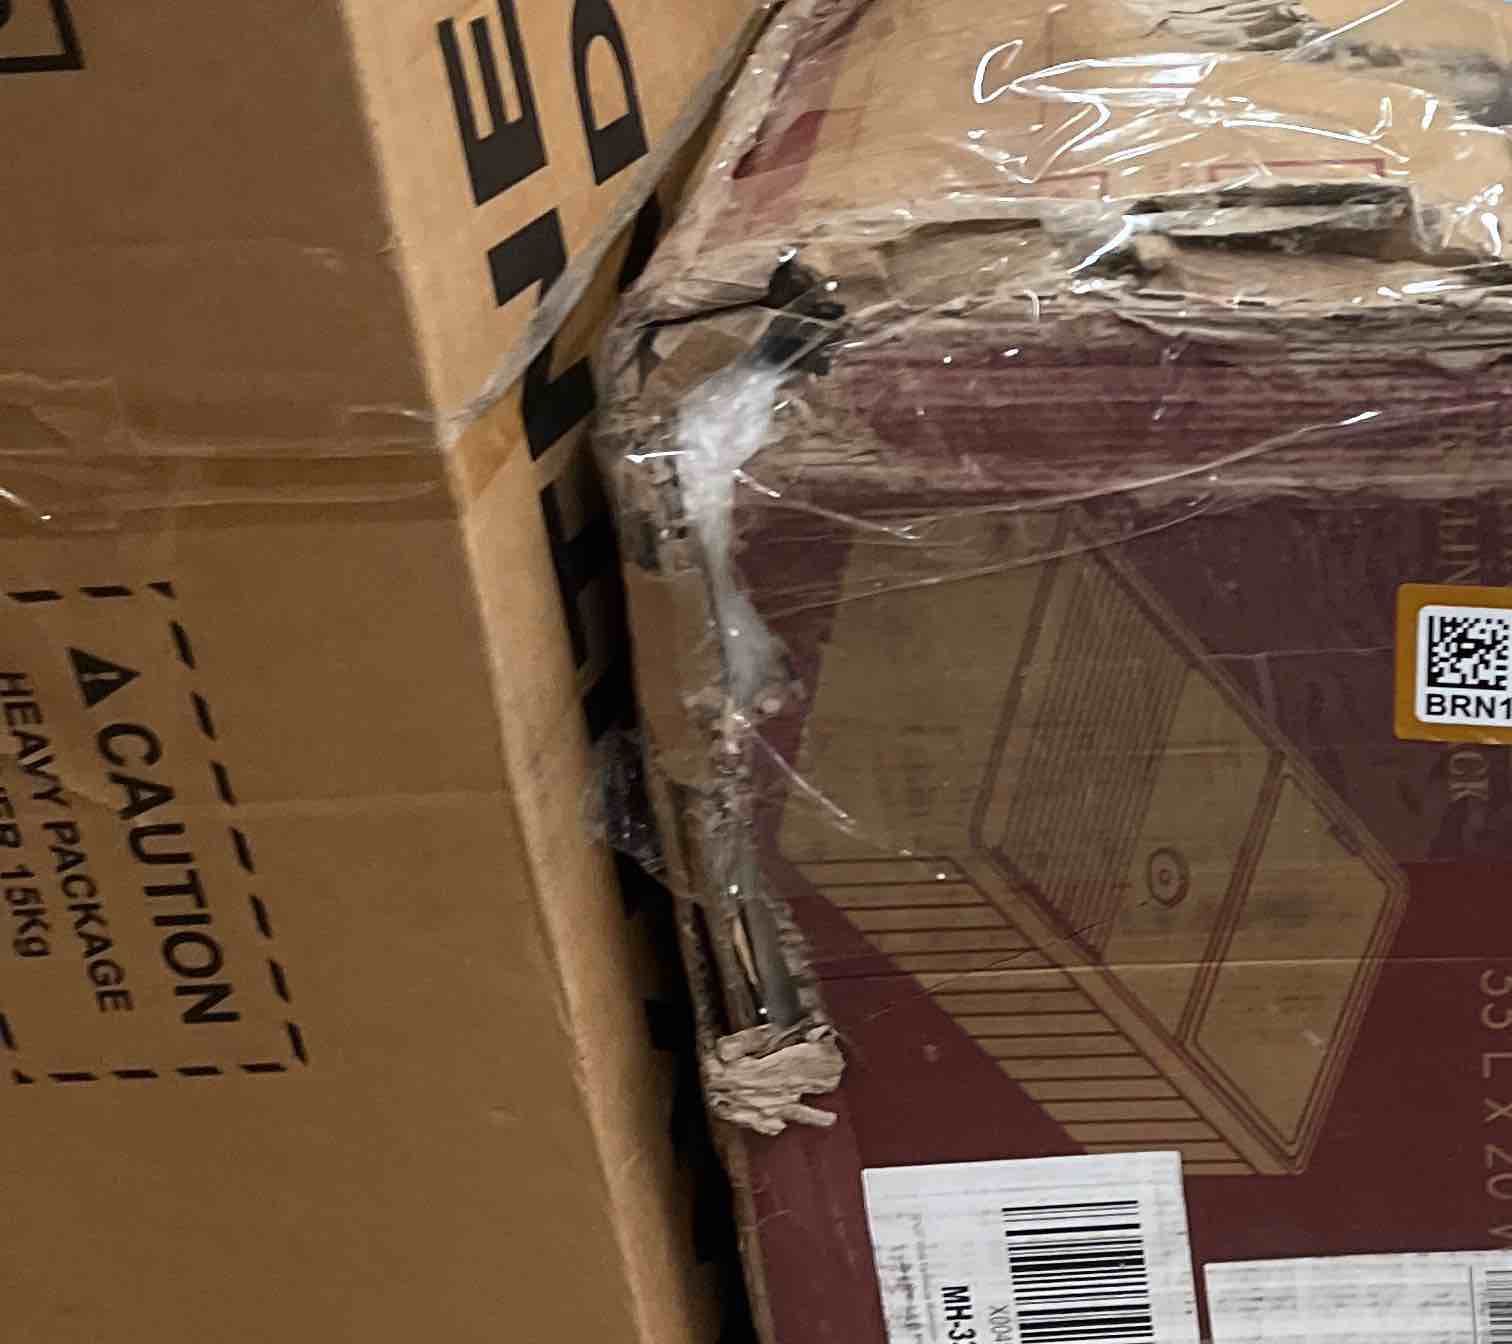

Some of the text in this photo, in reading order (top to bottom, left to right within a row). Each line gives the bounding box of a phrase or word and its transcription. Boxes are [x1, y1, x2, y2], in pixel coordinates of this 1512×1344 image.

[0, 672, 134, 1013] HEAVY PACKAGE
[96, 723, 240, 1025] CAUTION
